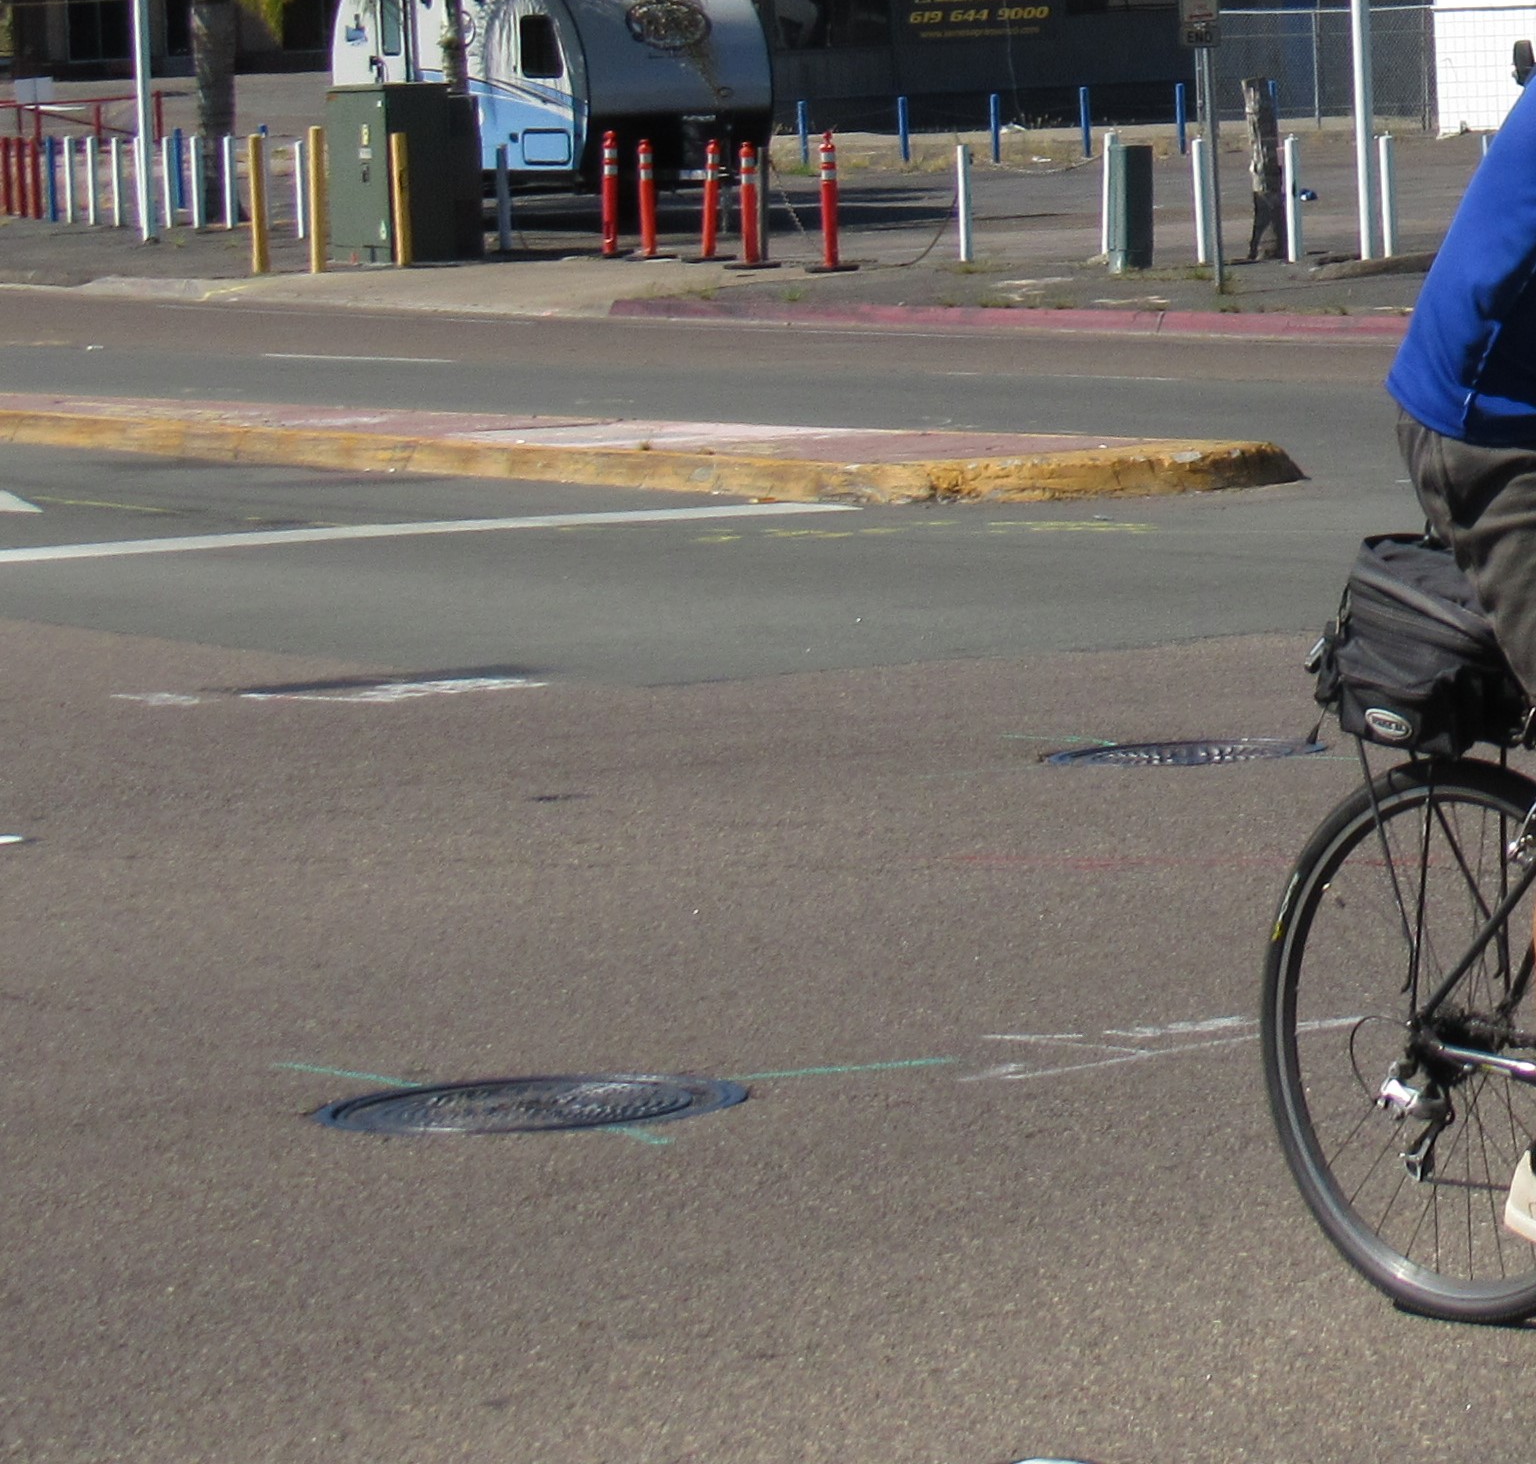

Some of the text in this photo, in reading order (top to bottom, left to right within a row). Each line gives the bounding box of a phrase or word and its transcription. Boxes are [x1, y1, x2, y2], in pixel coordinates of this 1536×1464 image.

[910, 5, 1050, 24] 619 644 9000
[1187, 31, 1213, 44] END
